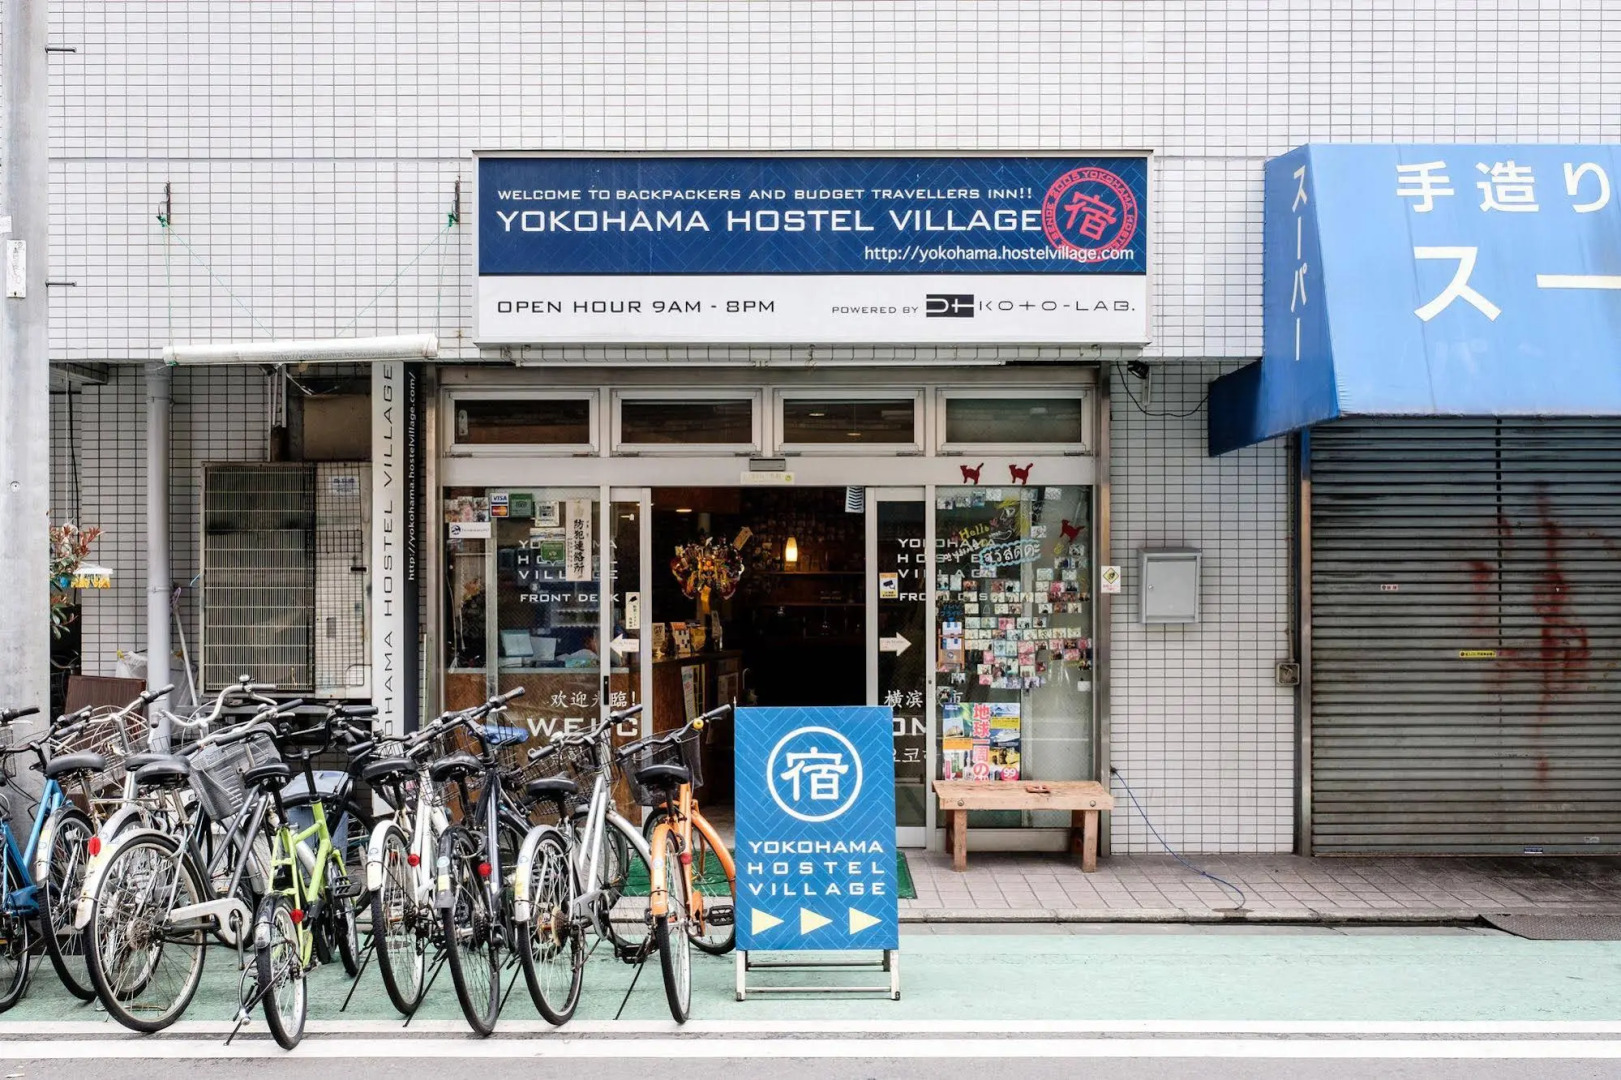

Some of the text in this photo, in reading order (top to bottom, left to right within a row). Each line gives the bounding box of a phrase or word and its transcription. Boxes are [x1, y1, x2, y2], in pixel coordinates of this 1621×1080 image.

[498, 187, 1032, 200] WELCOME TO BACKPACKERS AND BUDGET TRAVELLERS INN!!
[1052, 171, 1080, 198] 2005
[1081, 171, 1133, 208] YOKOHAMA
[1396, 160, 1611, 213] 手造り
[496, 210, 1042, 232] YOKOHAMA HOSTEL VILLAGE
[1063, 191, 1117, 241] 宿
[864, 245, 1134, 262] http://yokohama.hostelvillage.com
[1290, 164, 1308, 361] スーパー
[497, 300, 562, 313] OPEN
[573, 300, 641, 313] HOUR
[652, 300, 701, 313] 9AM
[726, 300, 774, 312] 8PM
[408, 371, 417, 581] http://yokohama.hostelvillage.com/
[959, 523, 990, 541] Hello
[383, 364, 393, 737] OHAMA HOSTEL VILLAGE
[898, 538, 996, 548] YOOHAMA
[520, 594, 619, 602] FRONT DEK
[780, 746, 849, 801] 宿
[748, 840, 884, 854] YOKOHAMA
[748, 861, 885, 875] HOSTEL
[749, 882, 886, 896] VILLAGE
